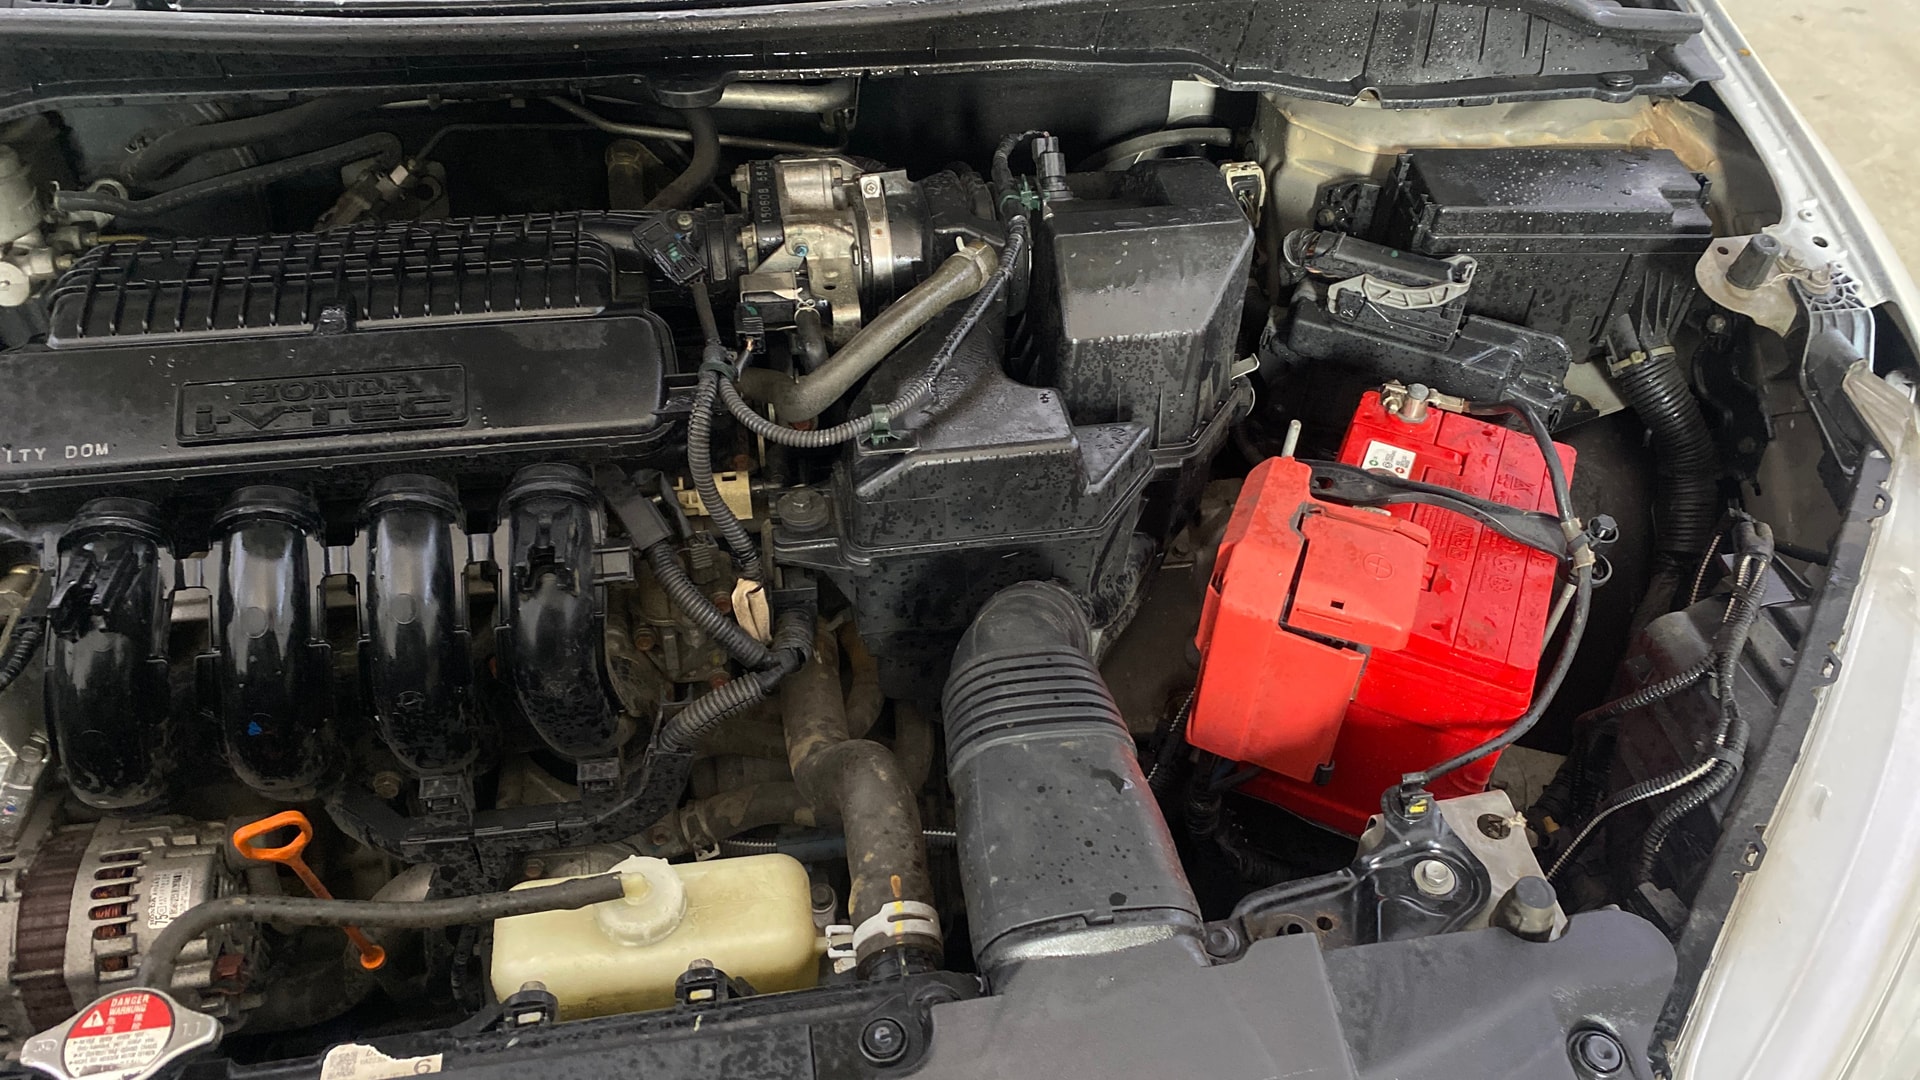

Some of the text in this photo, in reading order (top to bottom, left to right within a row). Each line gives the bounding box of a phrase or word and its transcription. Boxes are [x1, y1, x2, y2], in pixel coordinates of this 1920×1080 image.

[238, 375, 426, 405] HONDA
[194, 395, 453, 436] i-VTEC
[64, 442, 110, 460] DOM
[110, 993, 150, 1008] DANGER
